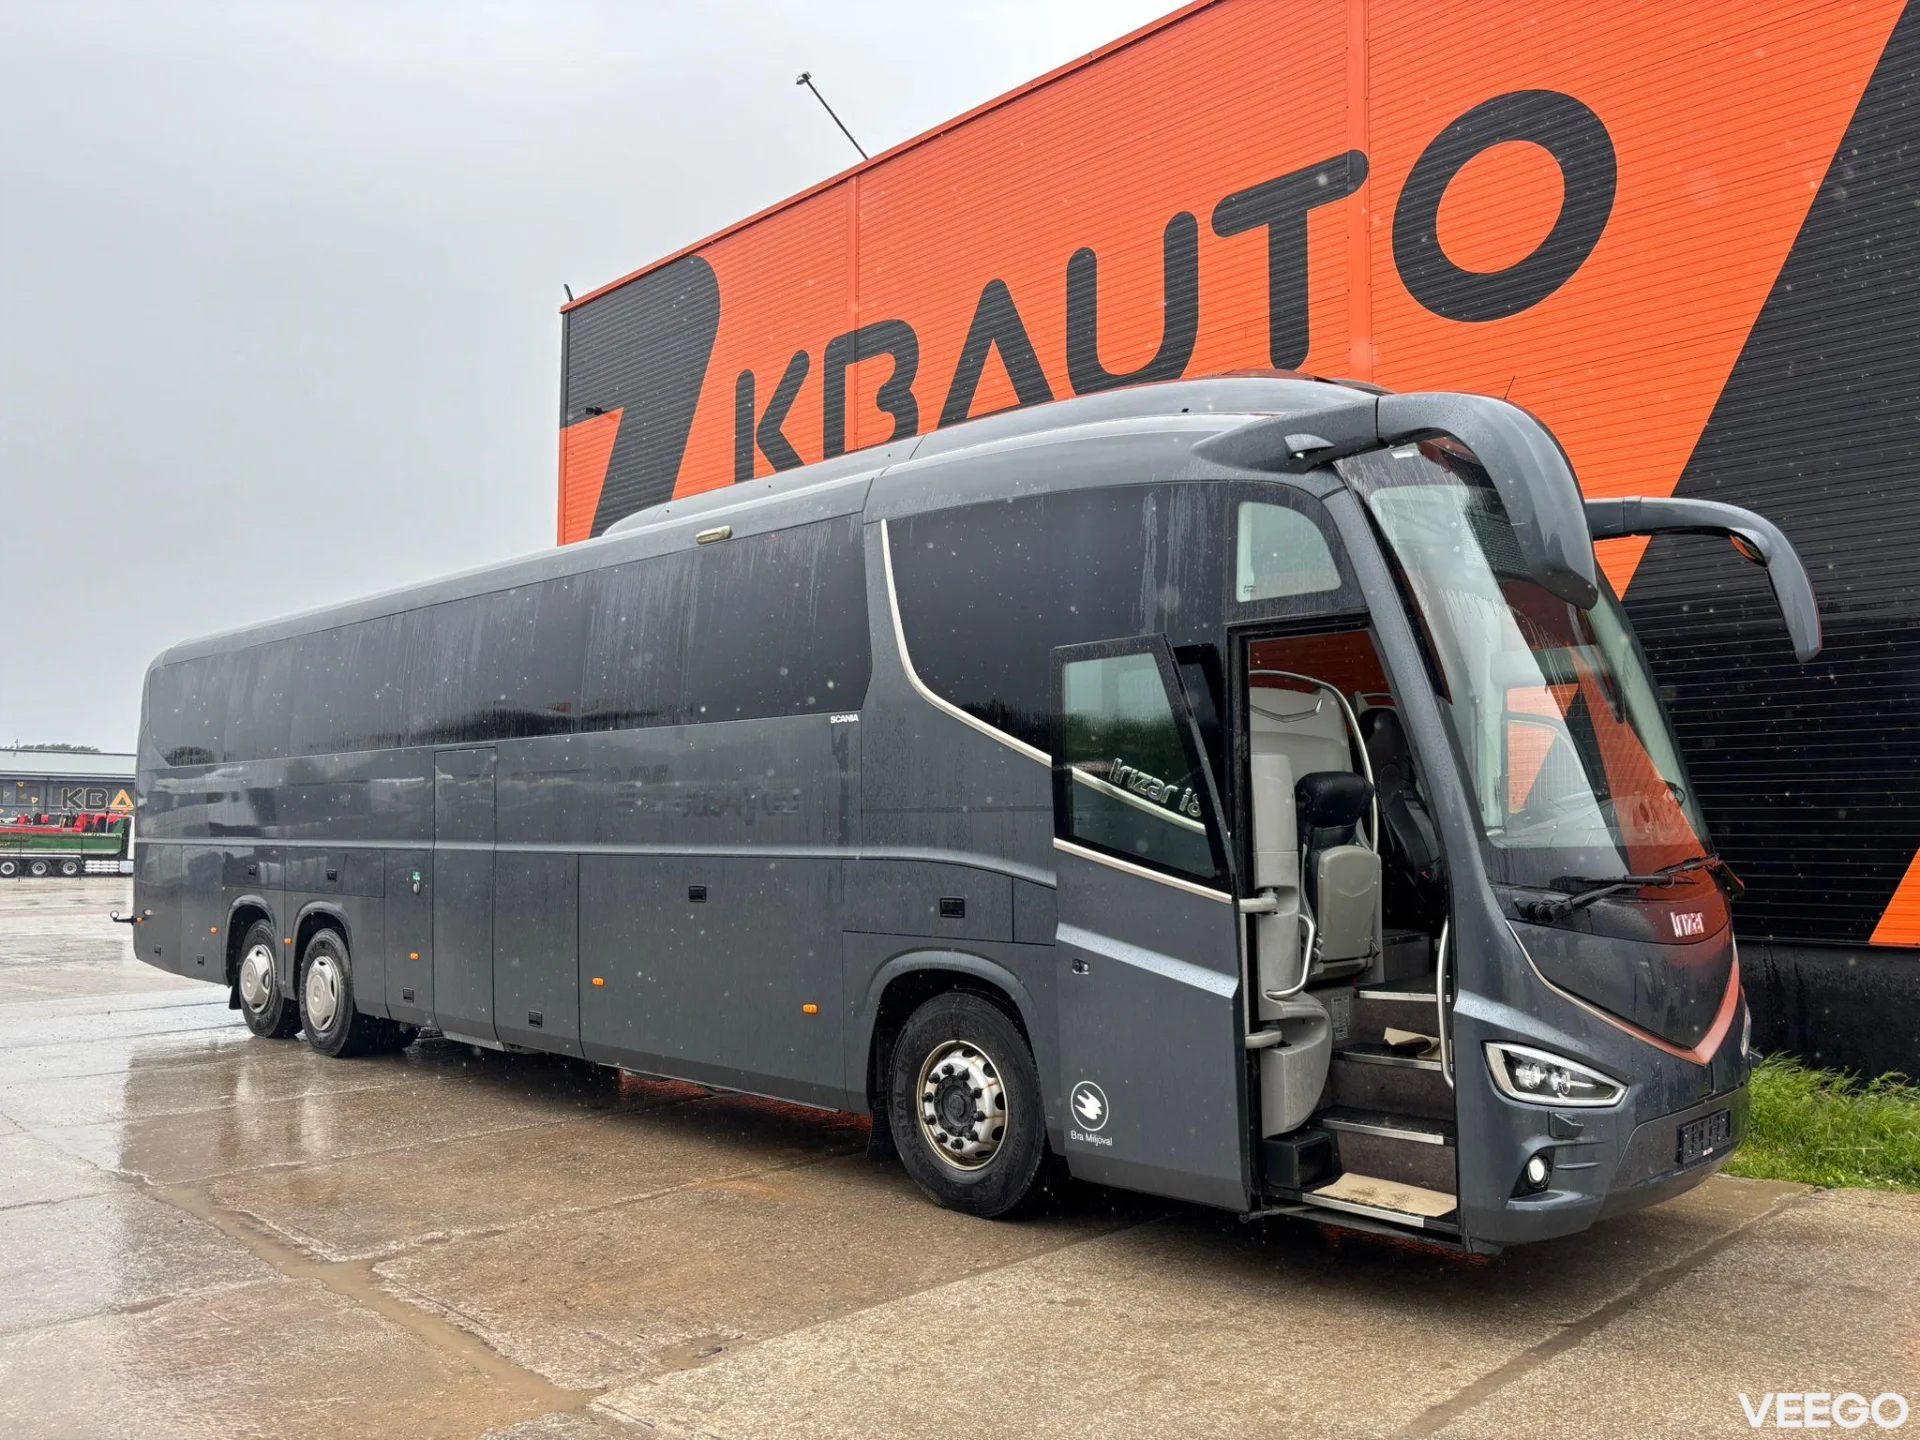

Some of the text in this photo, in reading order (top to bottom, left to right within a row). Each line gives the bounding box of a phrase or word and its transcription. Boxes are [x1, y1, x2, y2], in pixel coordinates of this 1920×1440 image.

[734, 89, 1618, 481] KBAUTO
[830, 714, 859, 723] SCANIA
[1109, 758, 1179, 804] Irizar
[1070, 1130, 1084, 1141] Bra
